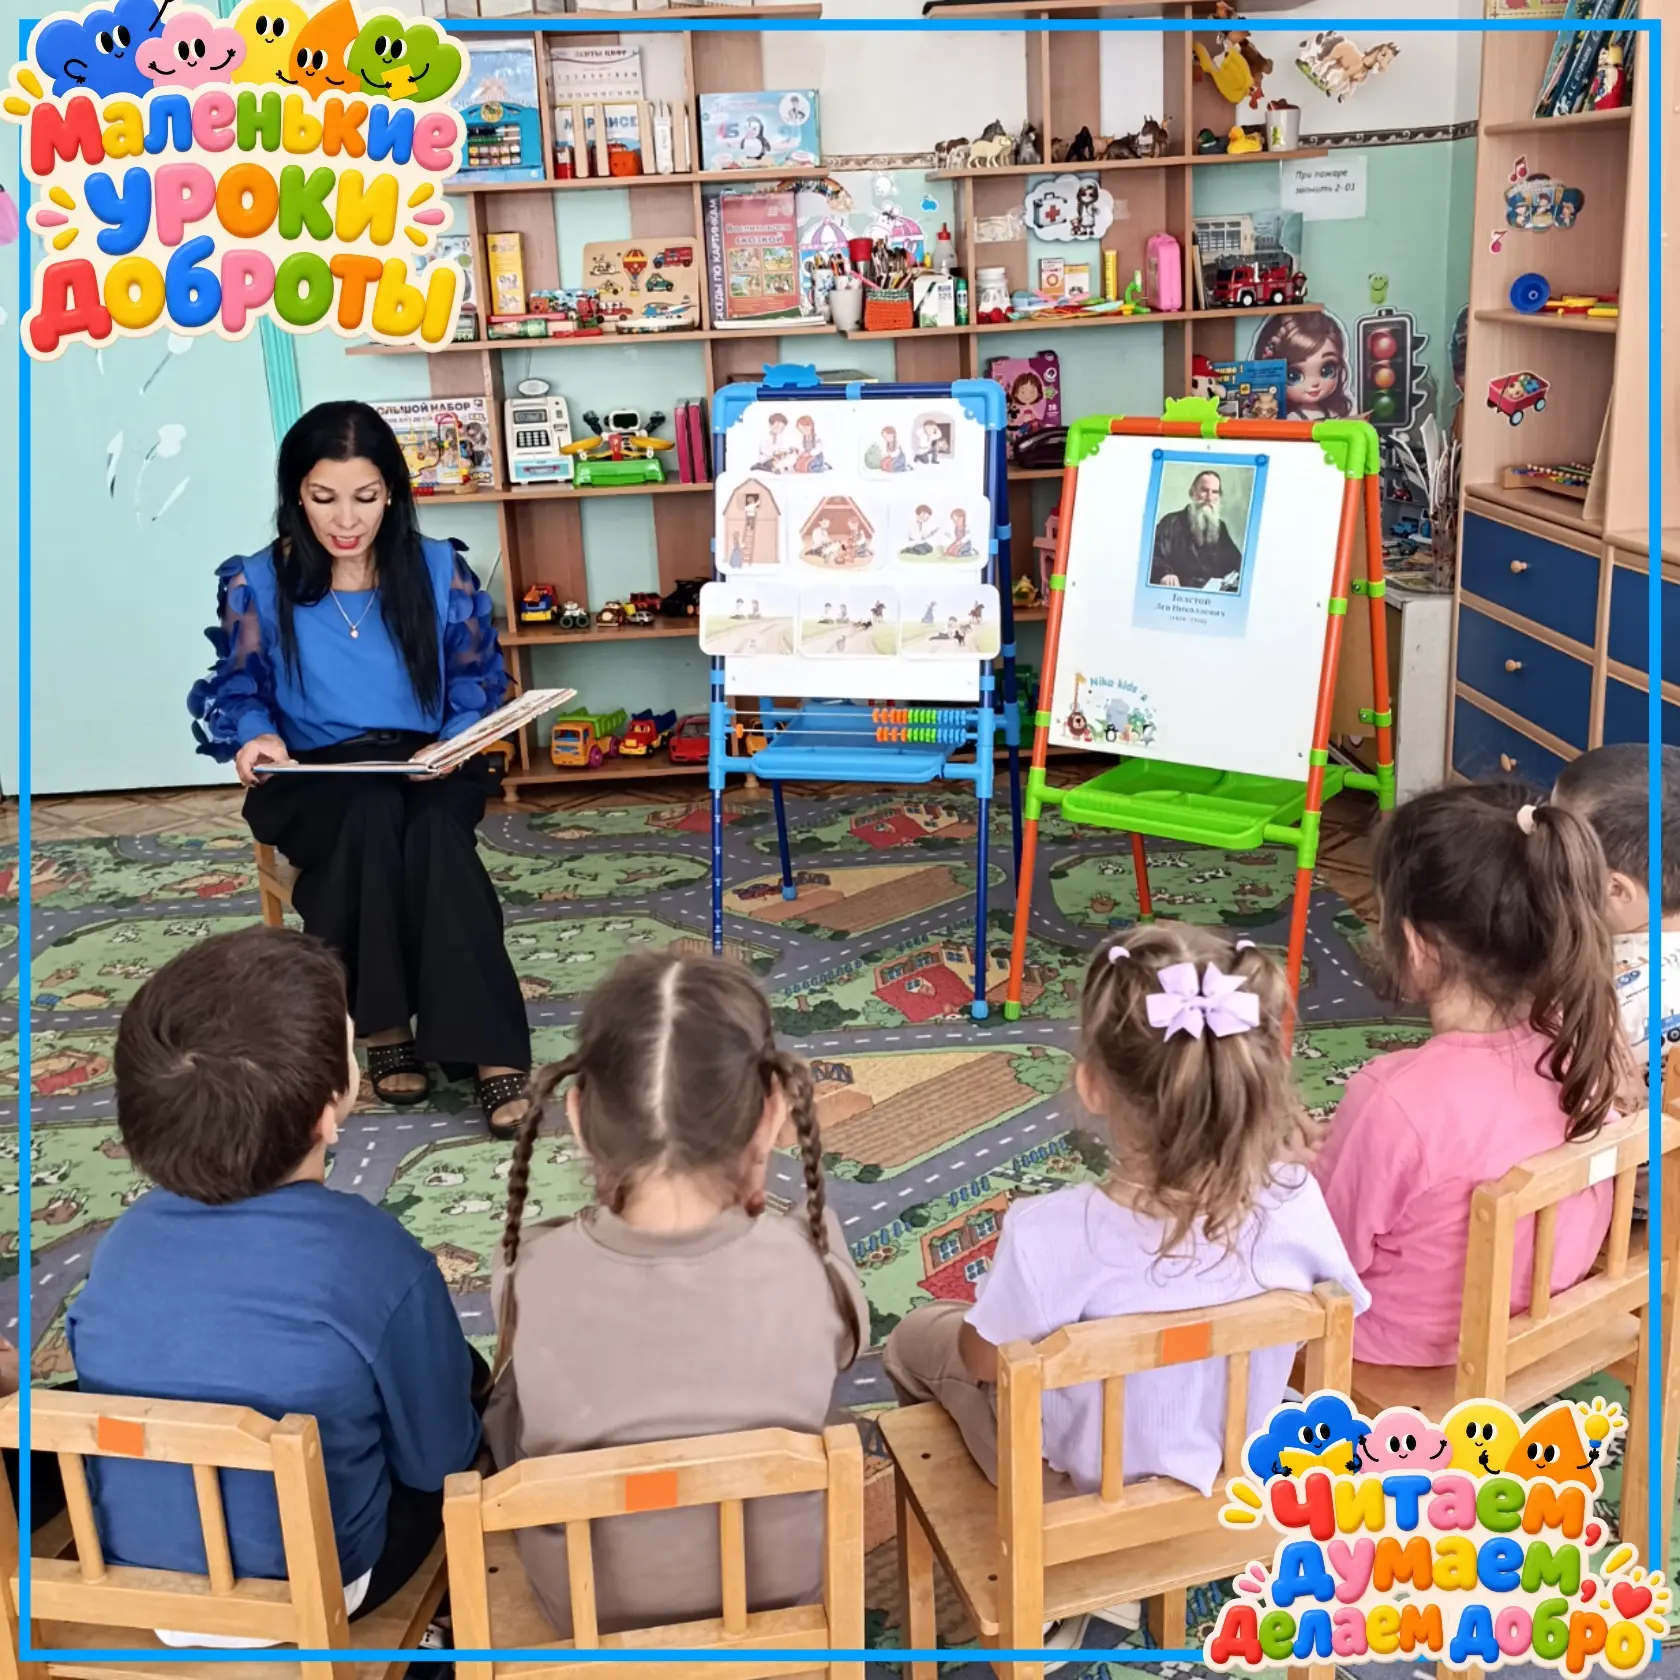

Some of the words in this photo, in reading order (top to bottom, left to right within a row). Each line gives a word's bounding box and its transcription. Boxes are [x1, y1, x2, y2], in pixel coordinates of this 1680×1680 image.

[1295, 170, 1312, 181] При
[1314, 169, 1349, 178] пожаре
[709, 199, 722, 262] КАРТИНКАМ
[712, 265, 723, 281] ПО
[377, 402, 429, 415] ОЛЬШОЙ
[430, 402, 471, 411] НАБОР
[1089, 676, 1114, 687] Nika
[1117, 678, 1138, 694] kids
